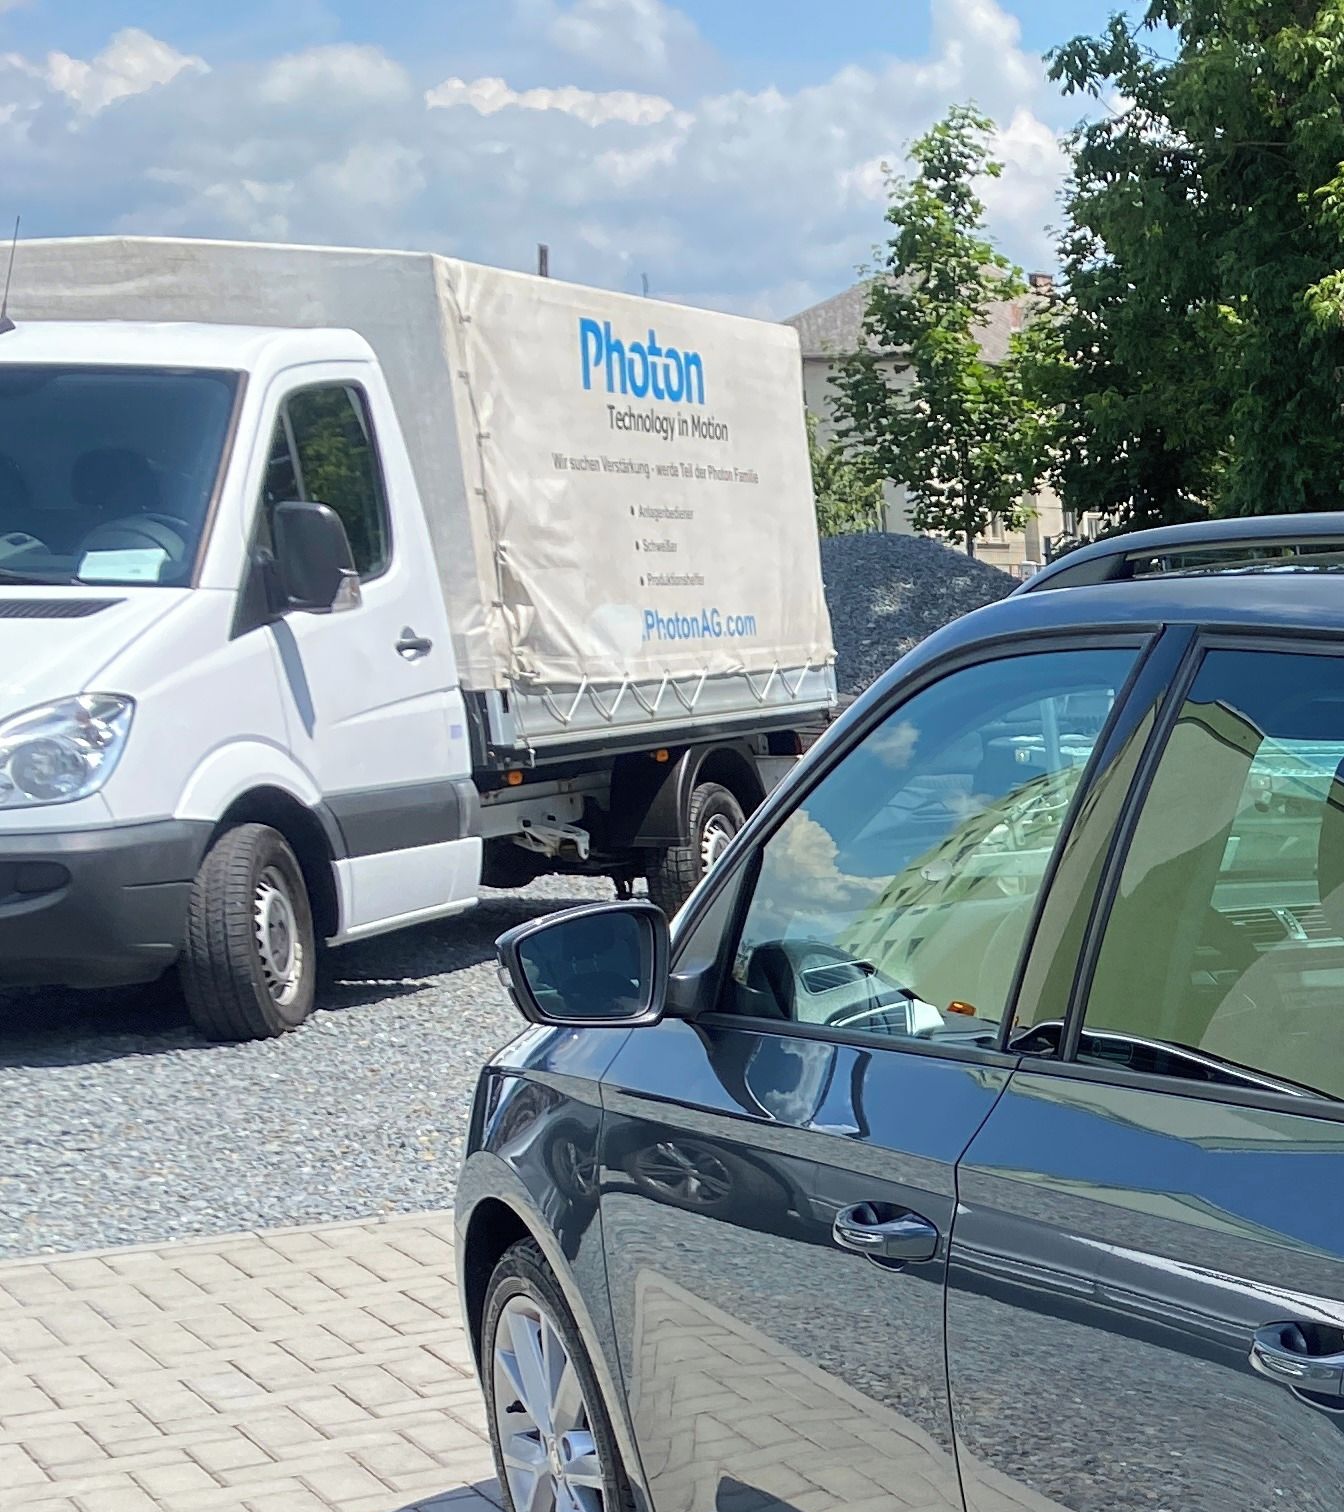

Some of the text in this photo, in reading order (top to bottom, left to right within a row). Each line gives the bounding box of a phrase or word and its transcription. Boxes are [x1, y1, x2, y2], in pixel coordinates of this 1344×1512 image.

[579, 317, 705, 405] Photon
[607, 404, 729, 442] Technology in Motion
[552, 453, 568, 470] Wir
[570, 456, 600, 471] suchen
[600, 455, 650, 479] Verstärkung
[656, 464, 679, 478] werde
[707, 465, 733, 482] Photon
[734, 467, 759, 484] Familie
